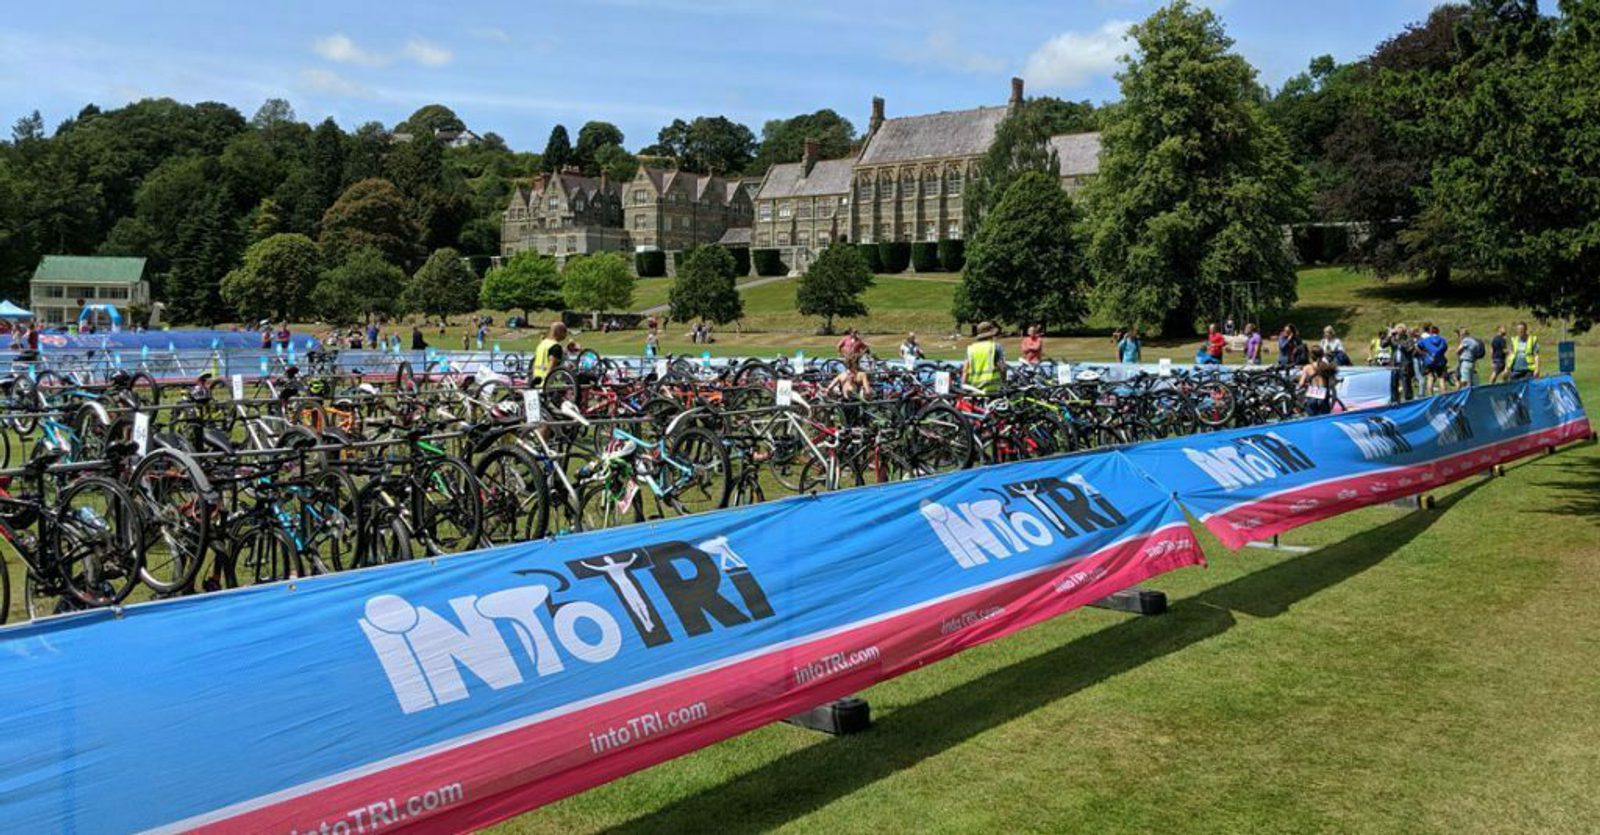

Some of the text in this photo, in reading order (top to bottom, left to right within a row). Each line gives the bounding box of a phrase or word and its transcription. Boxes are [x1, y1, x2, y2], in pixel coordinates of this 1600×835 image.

[793, 645, 880, 684] intoTRI.com
[589, 702, 708, 753] intoTRI.com
[291, 782, 464, 835] toTRI.com
